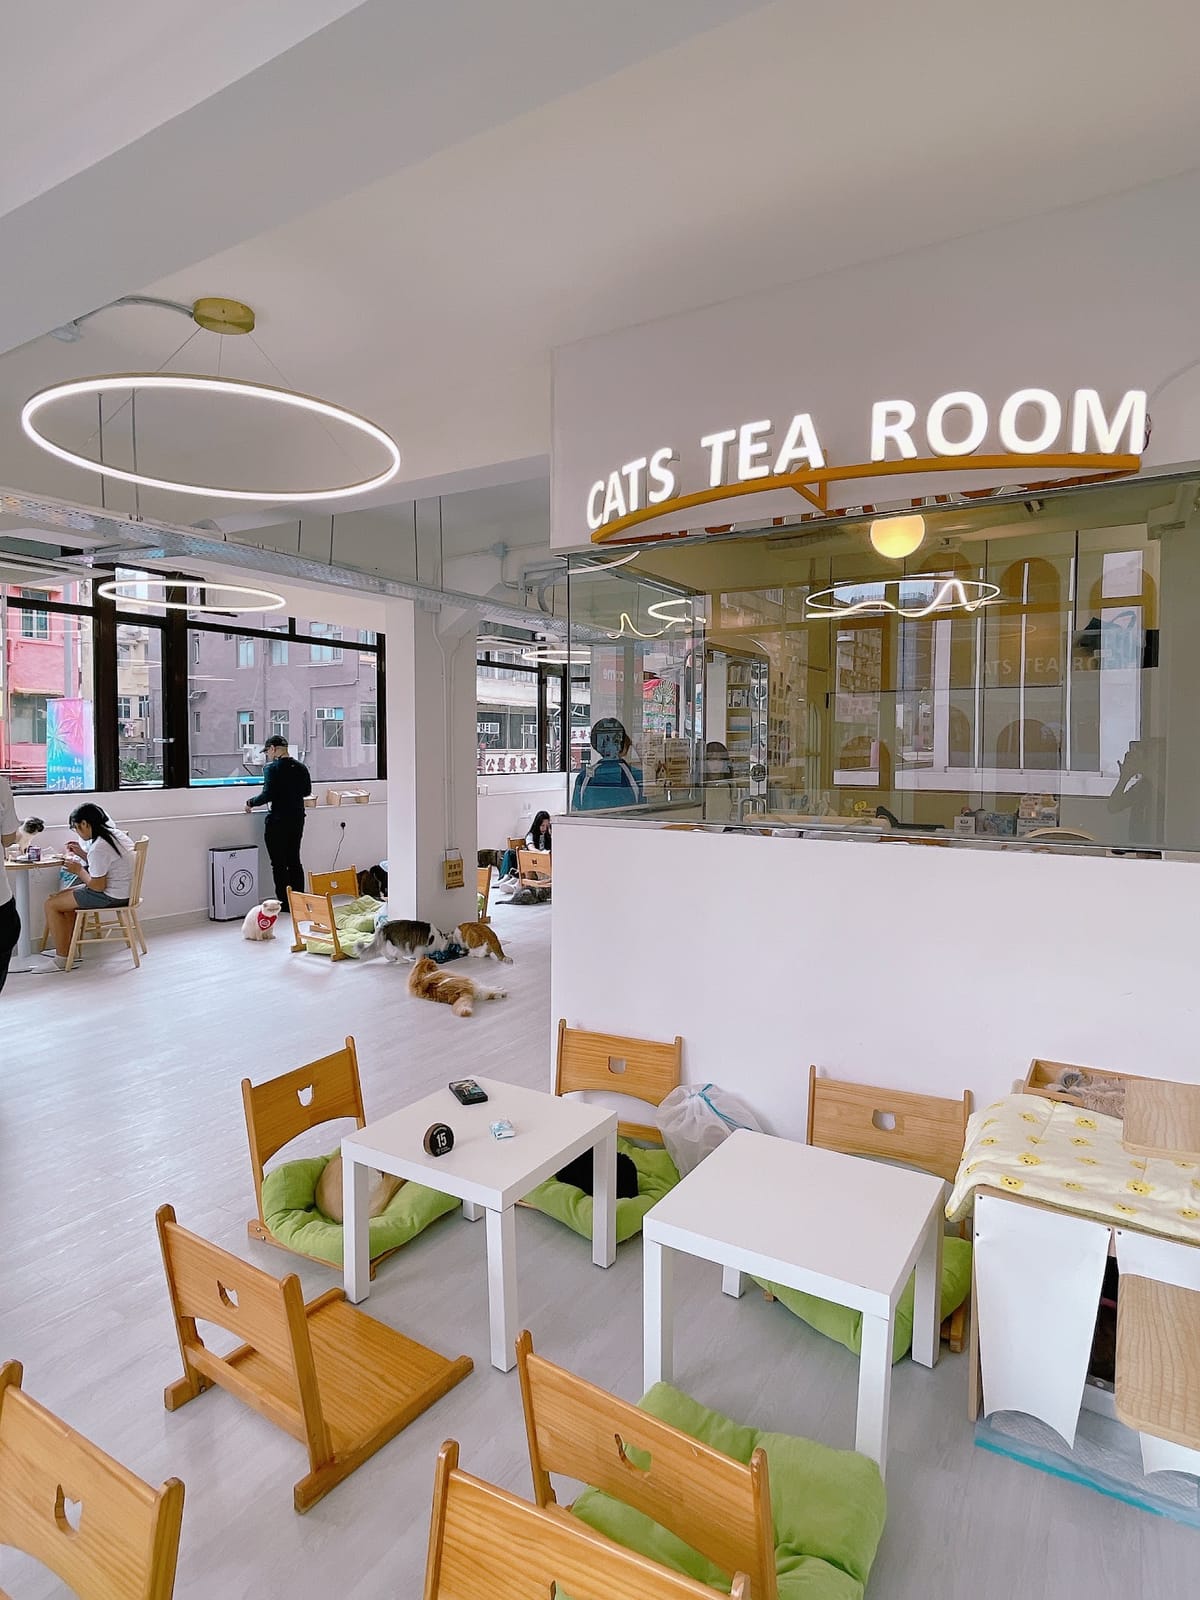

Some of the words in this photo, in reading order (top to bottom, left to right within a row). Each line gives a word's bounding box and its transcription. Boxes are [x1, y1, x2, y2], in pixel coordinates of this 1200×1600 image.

[586, 447, 676, 530] CATS
[700, 414, 825, 486] TEA
[871, 388, 1147, 461] ROOM
[436, 1132, 447, 1148] 15
